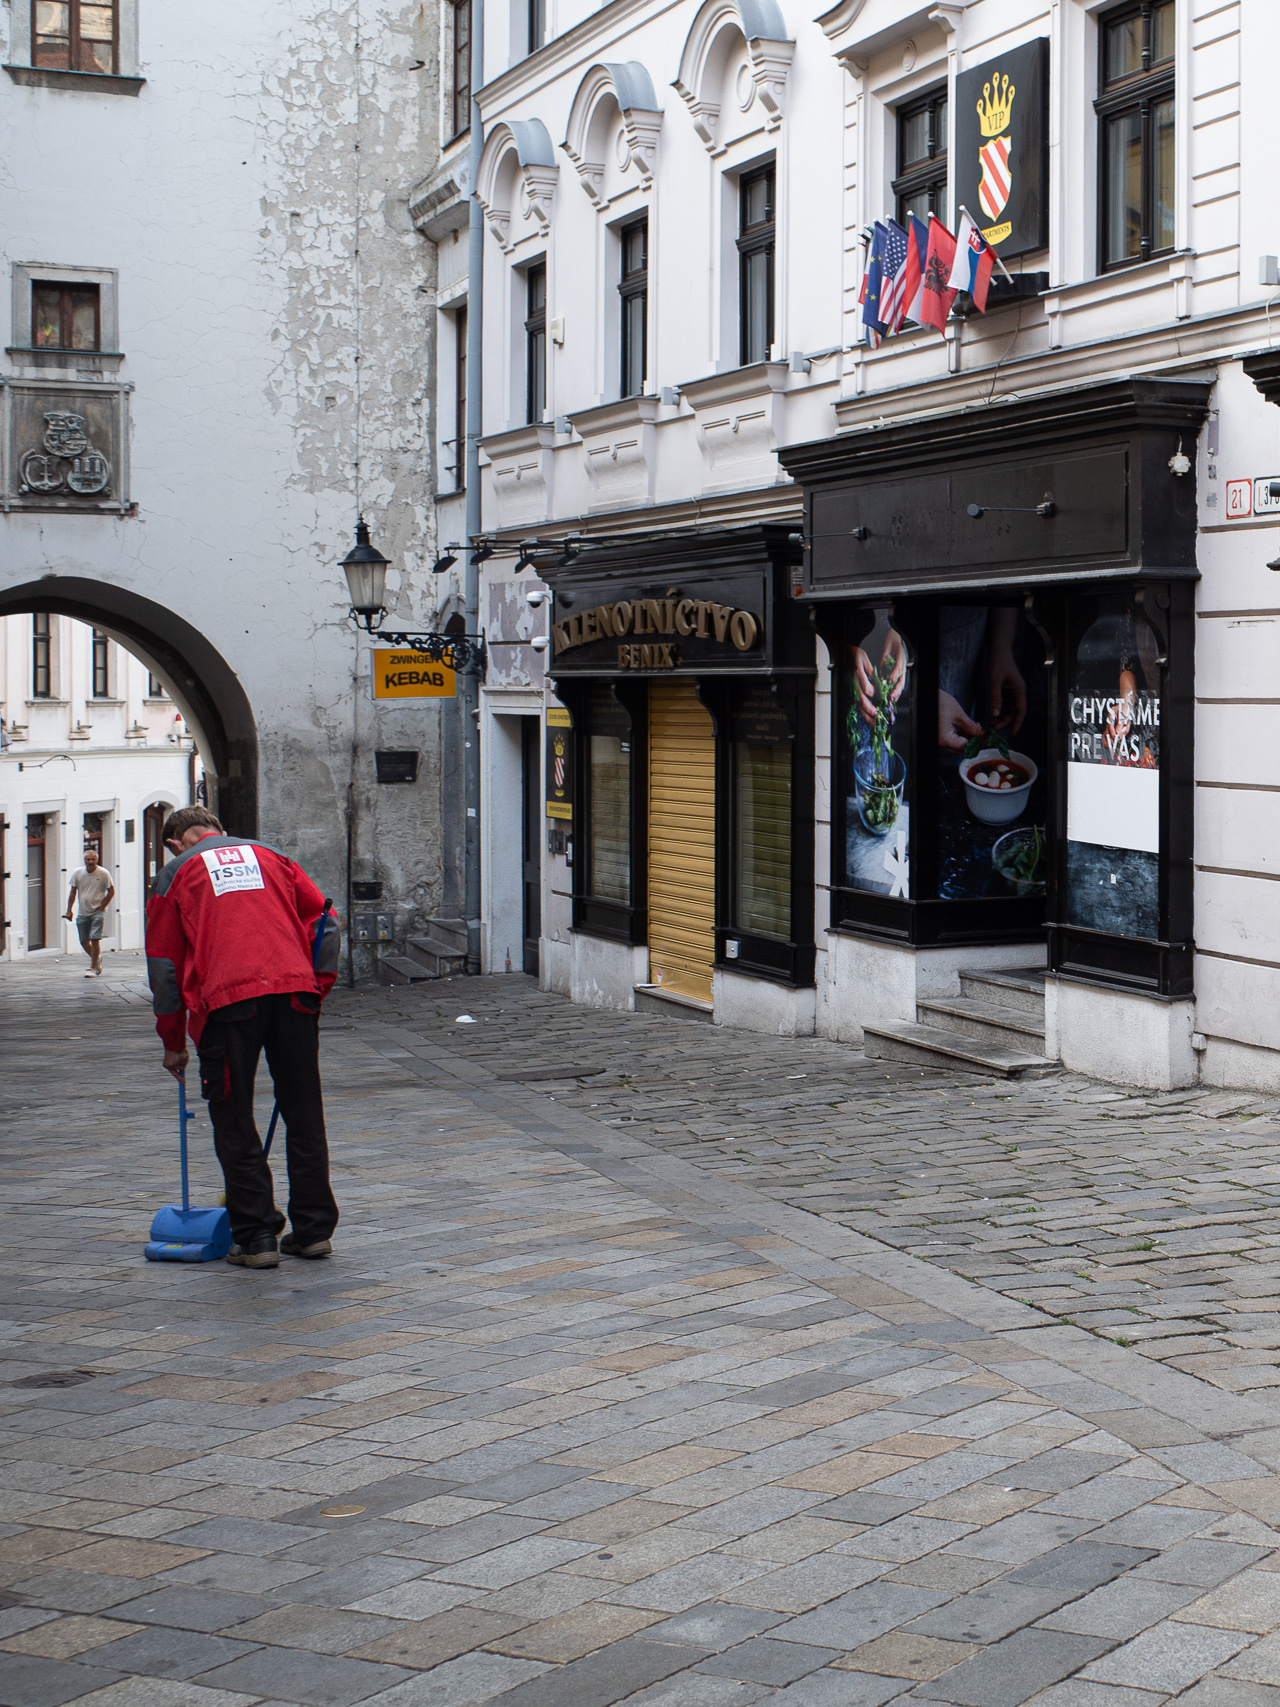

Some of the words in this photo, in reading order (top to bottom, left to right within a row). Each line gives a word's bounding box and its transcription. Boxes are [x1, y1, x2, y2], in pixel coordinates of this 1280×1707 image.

[987, 110, 1005, 131] VIP
[1231, 488, 1242, 509] 21
[385, 671, 444, 689] KEBAB
[1071, 732, 1103, 760] PRE
[1106, 726, 1140, 762] VÁS
[210, 864, 260, 881] TSSM
